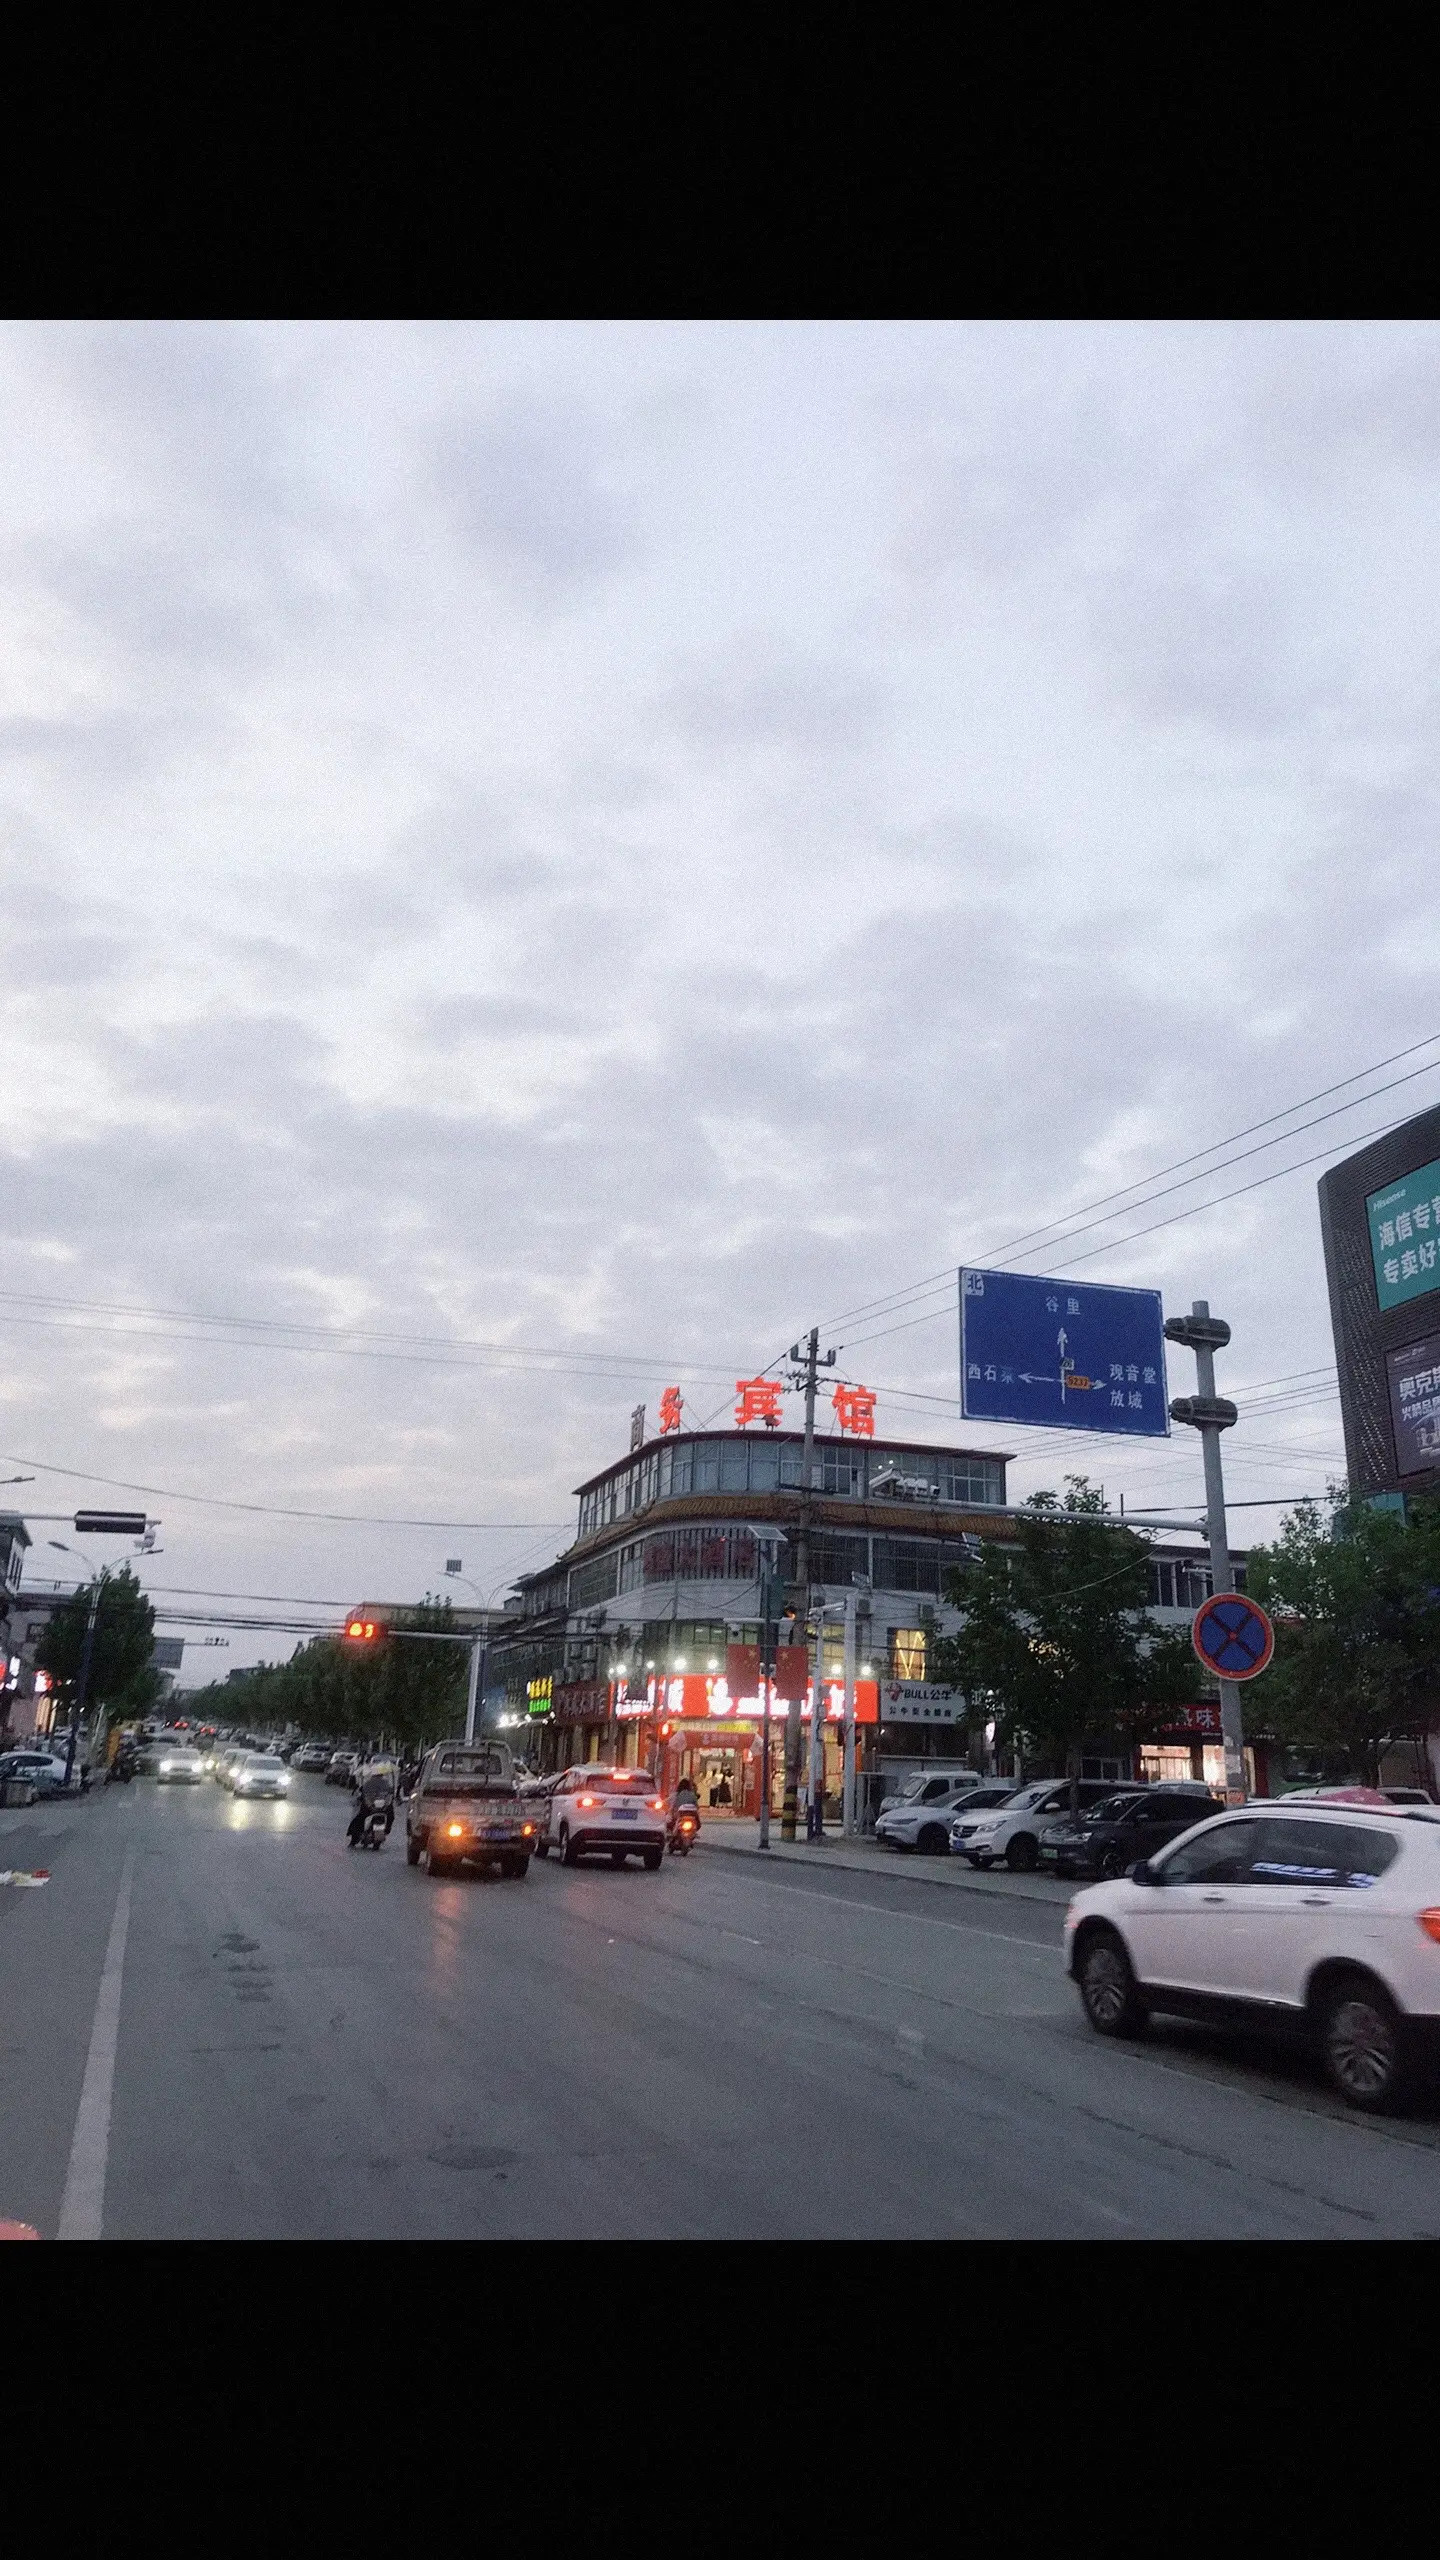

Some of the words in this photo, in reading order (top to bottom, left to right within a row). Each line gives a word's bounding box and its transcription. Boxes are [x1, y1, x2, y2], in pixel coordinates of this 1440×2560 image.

[1383, 1239, 1440, 1284] 专卖好
[967, 1274, 982, 1290] 北
[1045, 1296, 1081, 1315] 谷里
[1109, 1363, 1156, 1385] 观音堂
[1110, 1388, 1143, 1409] 放城
